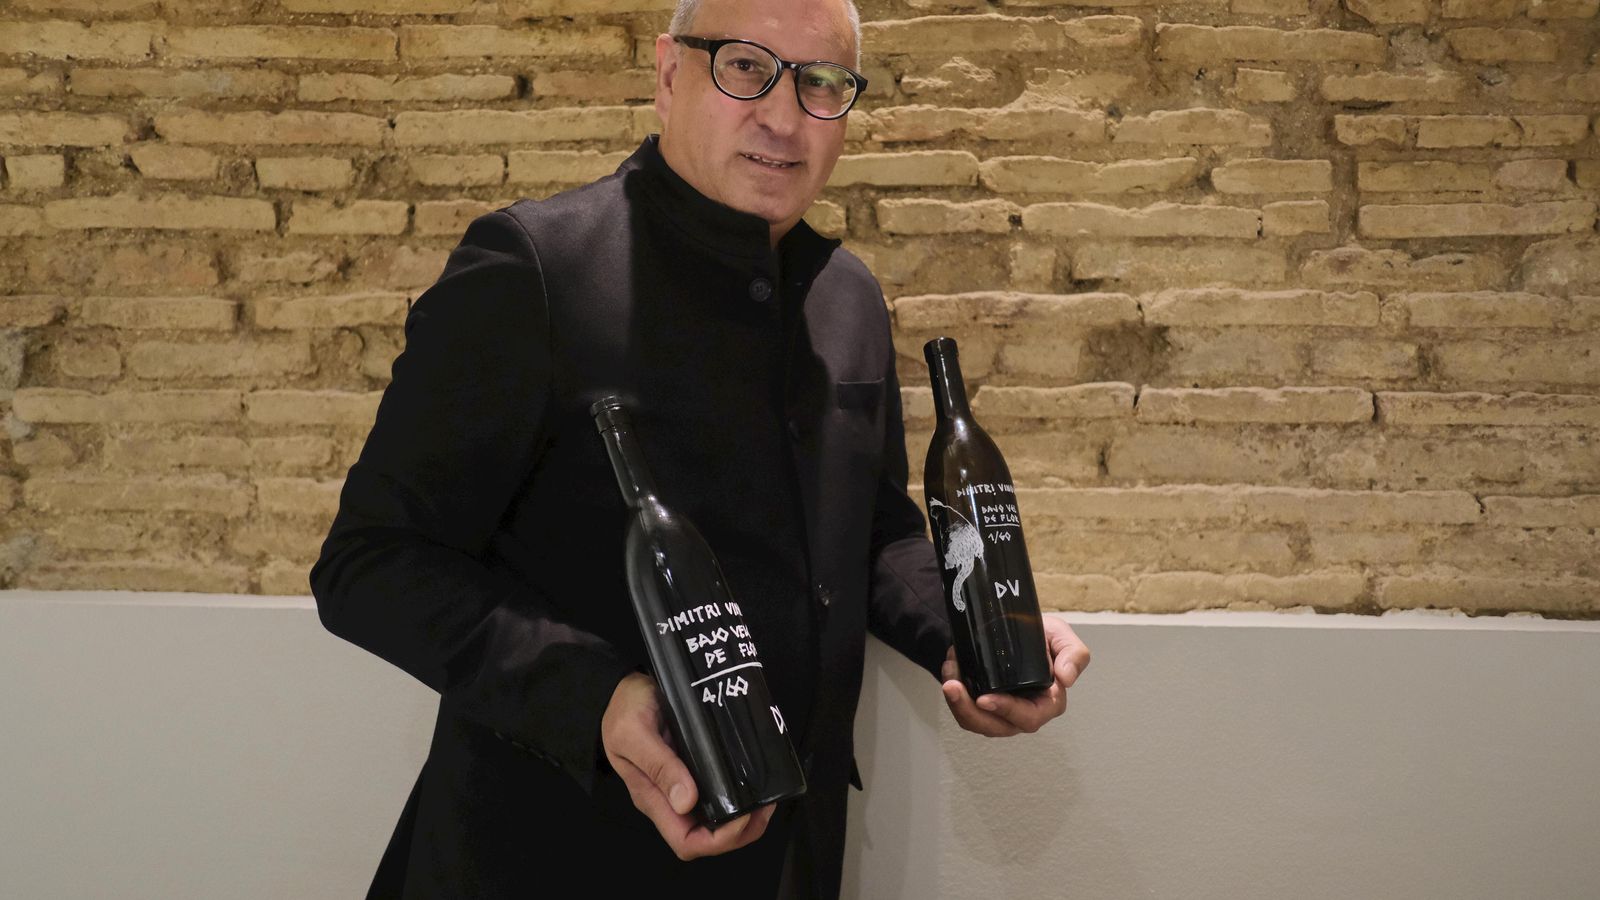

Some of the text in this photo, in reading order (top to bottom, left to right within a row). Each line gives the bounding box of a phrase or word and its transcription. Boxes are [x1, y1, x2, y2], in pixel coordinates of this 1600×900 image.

[984, 514, 998, 524] DE
[987, 530, 1012, 544] 1/60
[994, 579, 1020, 599] DV
[686, 627, 730, 654] BAJO
[704, 648, 727, 669] DE
[702, 675, 749, 707] 4/60
